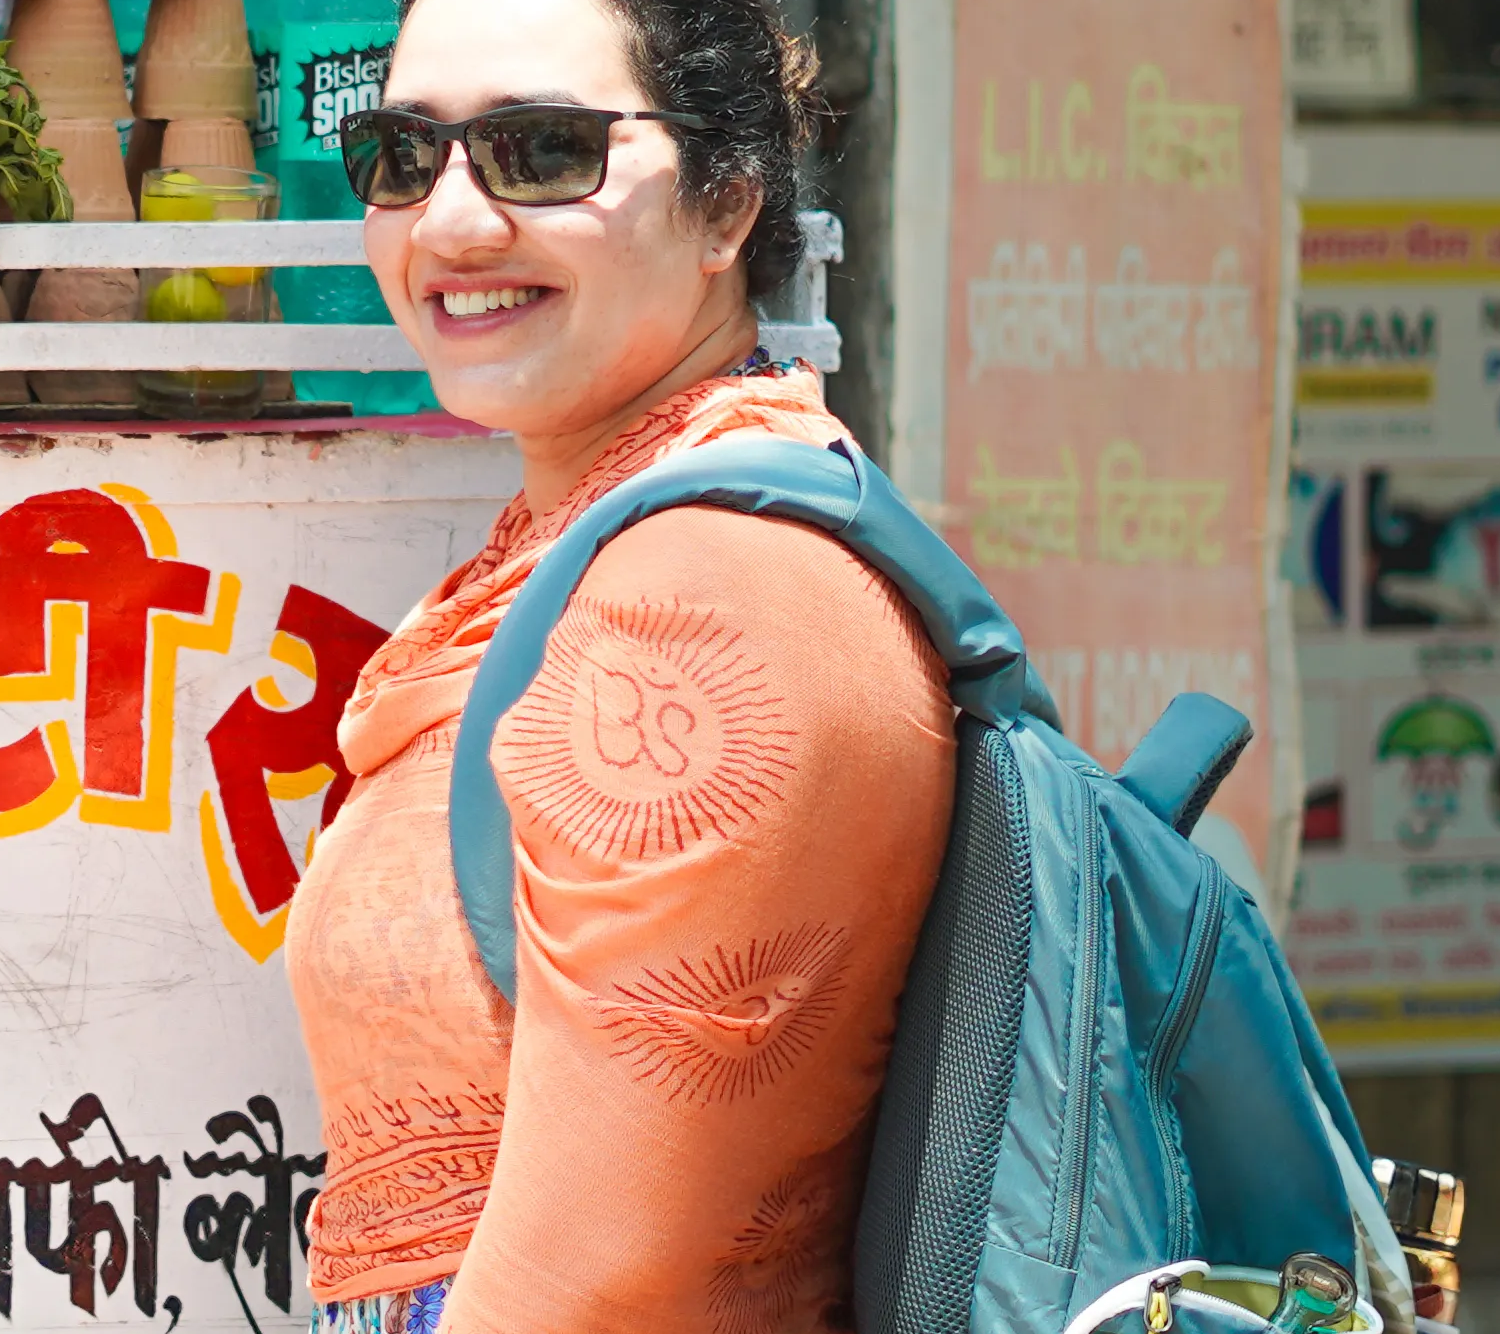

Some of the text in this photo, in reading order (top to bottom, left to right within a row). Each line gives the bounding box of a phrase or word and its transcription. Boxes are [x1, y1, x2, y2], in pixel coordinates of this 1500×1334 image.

[313, 54, 388, 92] Bisler
[981, 78, 1108, 186] L.I.C.
[966, 438, 1229, 569] रेलवे टिकट
